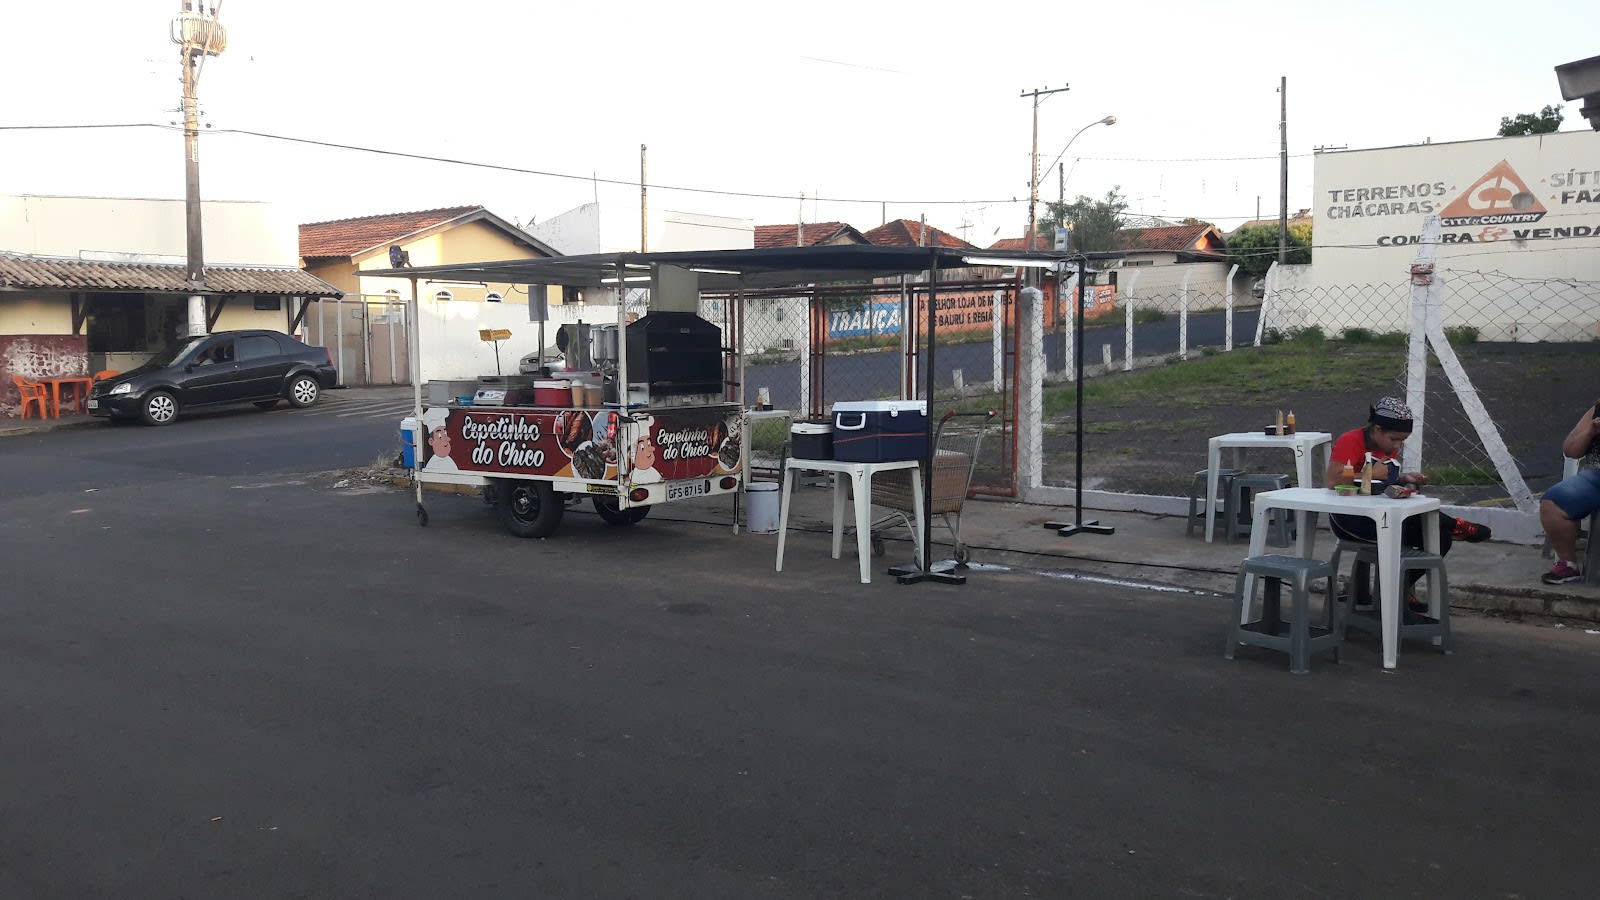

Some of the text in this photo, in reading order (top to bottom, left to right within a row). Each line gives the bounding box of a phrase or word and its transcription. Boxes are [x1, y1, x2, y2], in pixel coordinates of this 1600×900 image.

[1327, 182, 1447, 203] TERRENOS
[1326, 200, 1434, 220] CHÁCARAS
[1441, 217, 1471, 226] CITY
[1480, 213, 1541, 225] COUNTRY
[1376, 232, 1474, 247] COMRA
[957, 296, 976, 309] LOJA
[977, 295, 986, 307] DE
[831, 305, 901, 334] TRADIÇÃ
[938, 313, 965, 327] BAURU
[967, 312, 972, 325] E
[972, 308, 993, 323] REGIÃ
[462, 416, 541, 445] Espetinho
[657, 428, 708, 446] Espetinho
[472, 440, 545, 467] do Chico
[663, 442, 710, 460] do Chico
[1296, 444, 1304, 458] 5
[856, 469, 864, 482] 7
[1381, 511, 1389, 529] 1
